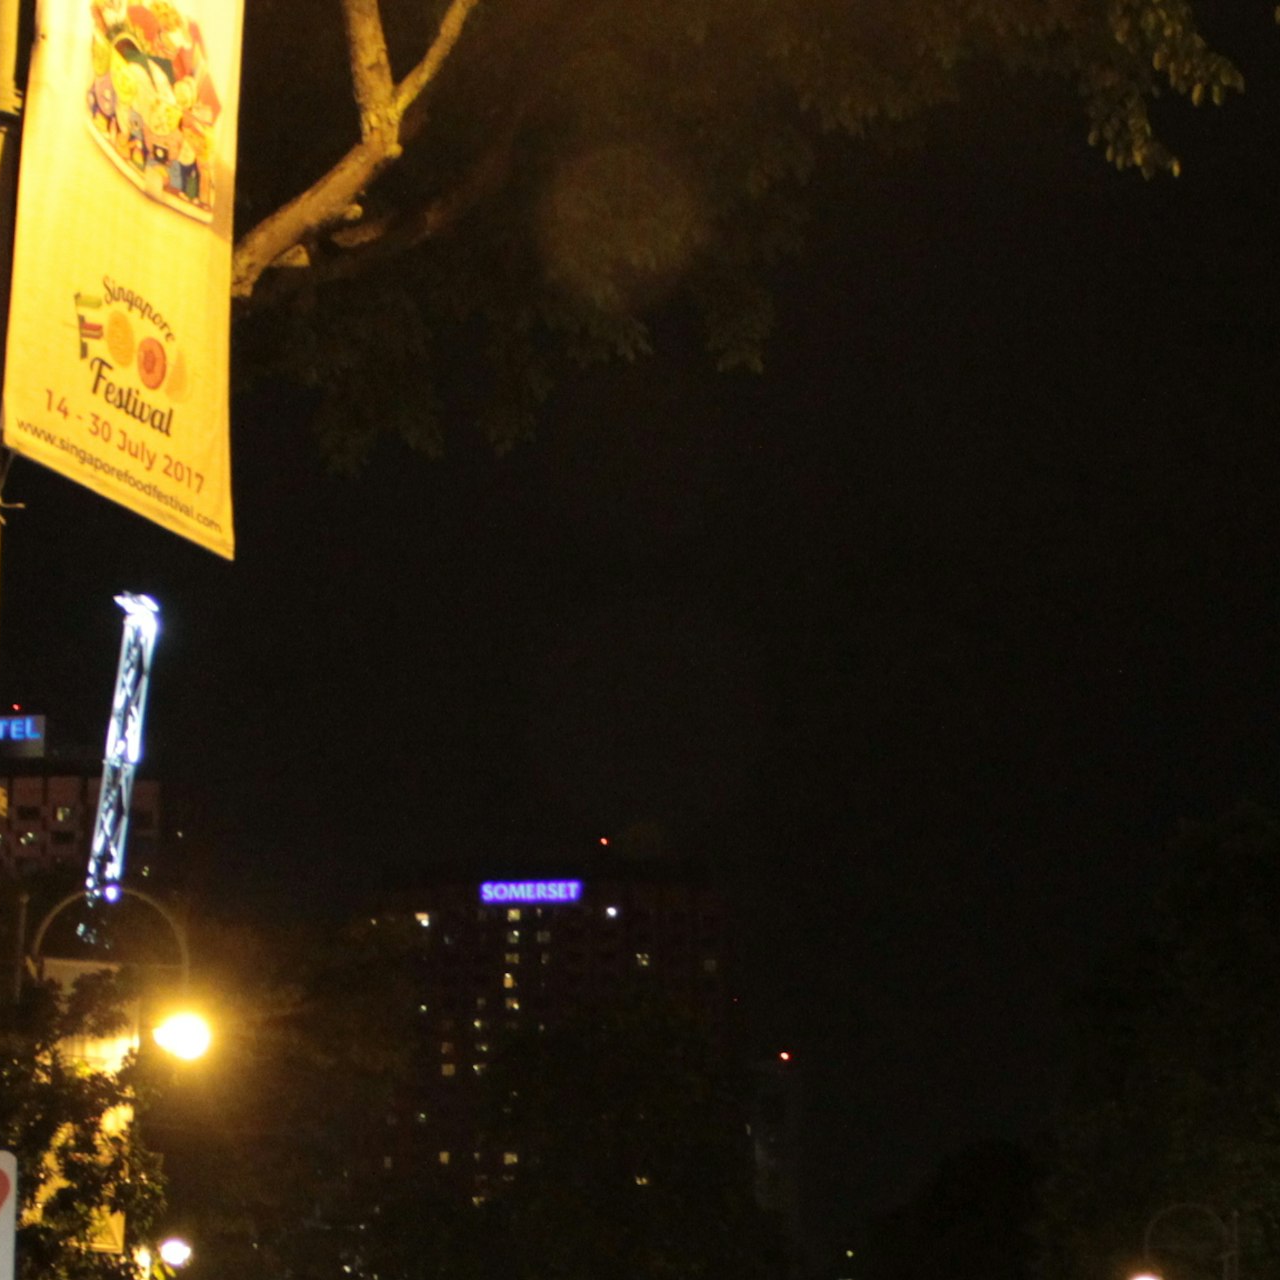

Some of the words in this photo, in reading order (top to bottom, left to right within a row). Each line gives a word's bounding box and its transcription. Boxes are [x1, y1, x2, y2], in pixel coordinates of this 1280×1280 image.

[101, 275, 176, 344] Singapore
[89, 357, 175, 437] Festival
[16, 417, 222, 533] www.singaporefoodfestival.com
[45, 389, 70, 420] 14
[88, 412, 112, 443] 30
[117, 429, 158, 472] July
[163, 454, 206, 494] 2017
[481, 882, 581, 901] SOMERSET
